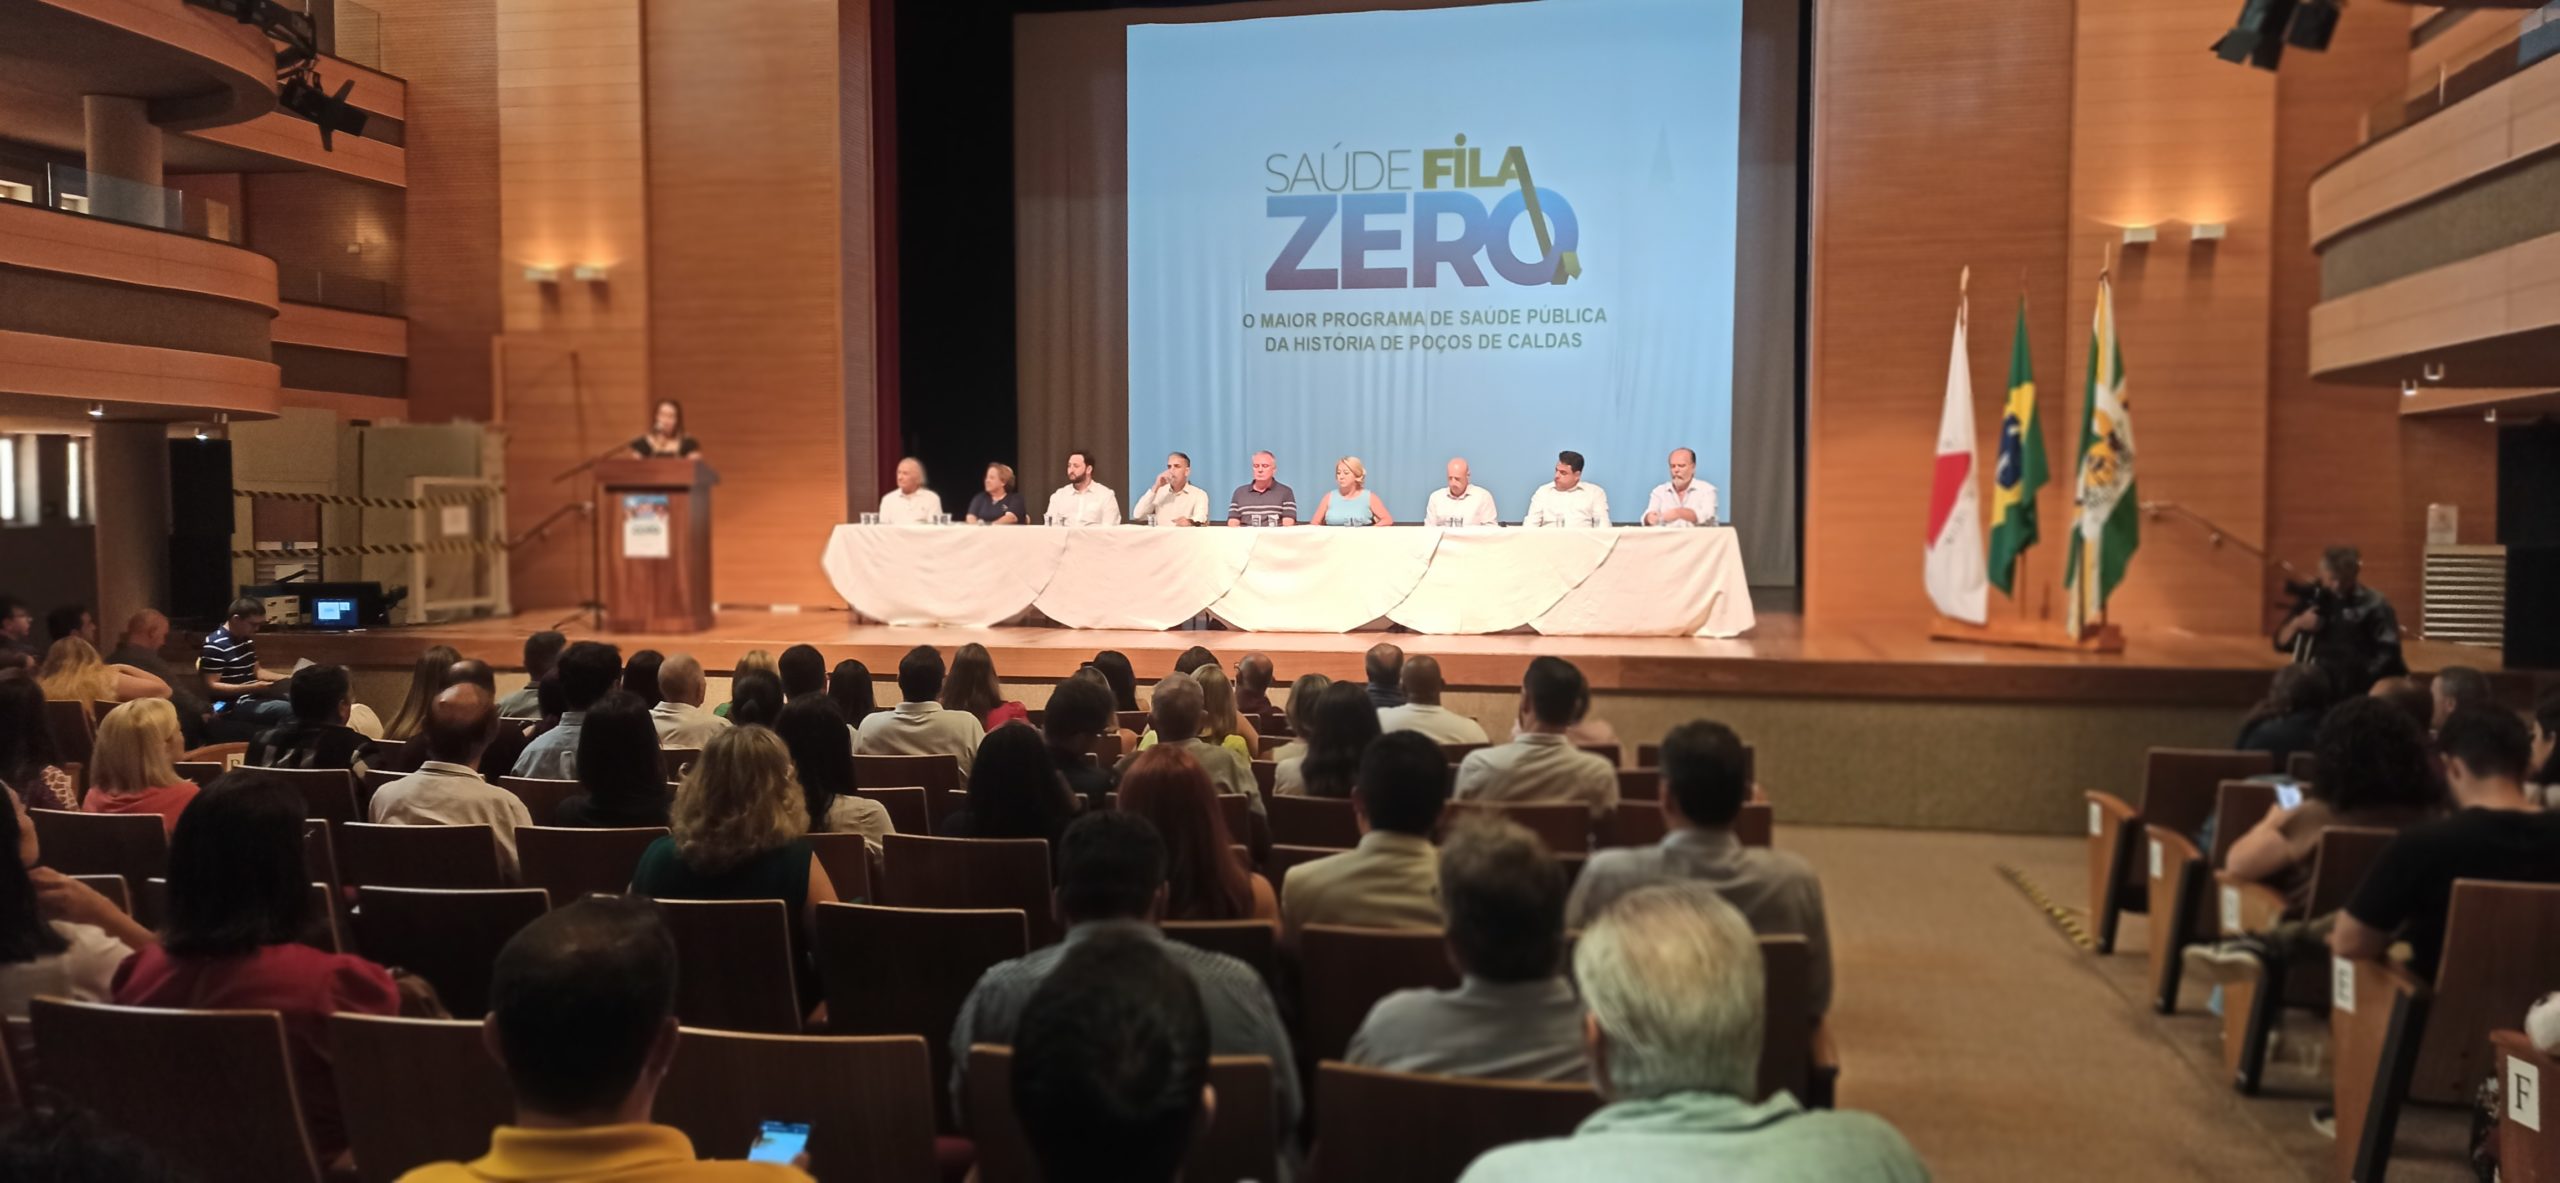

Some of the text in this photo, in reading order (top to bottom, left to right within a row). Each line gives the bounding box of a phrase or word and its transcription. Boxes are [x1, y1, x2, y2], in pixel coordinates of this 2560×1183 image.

[1265, 141, 1412, 193] SAÚDE
[1265, 187, 1579, 290] ZERO
[1243, 304, 1607, 328] O MAIOR PROGRAMA DE SAÚDE PÚBLICA
[1265, 332, 1582, 354] DA HISTÓRIA DE POÇOS DE CALDAS
[2514, 1072, 2531, 1110] F
